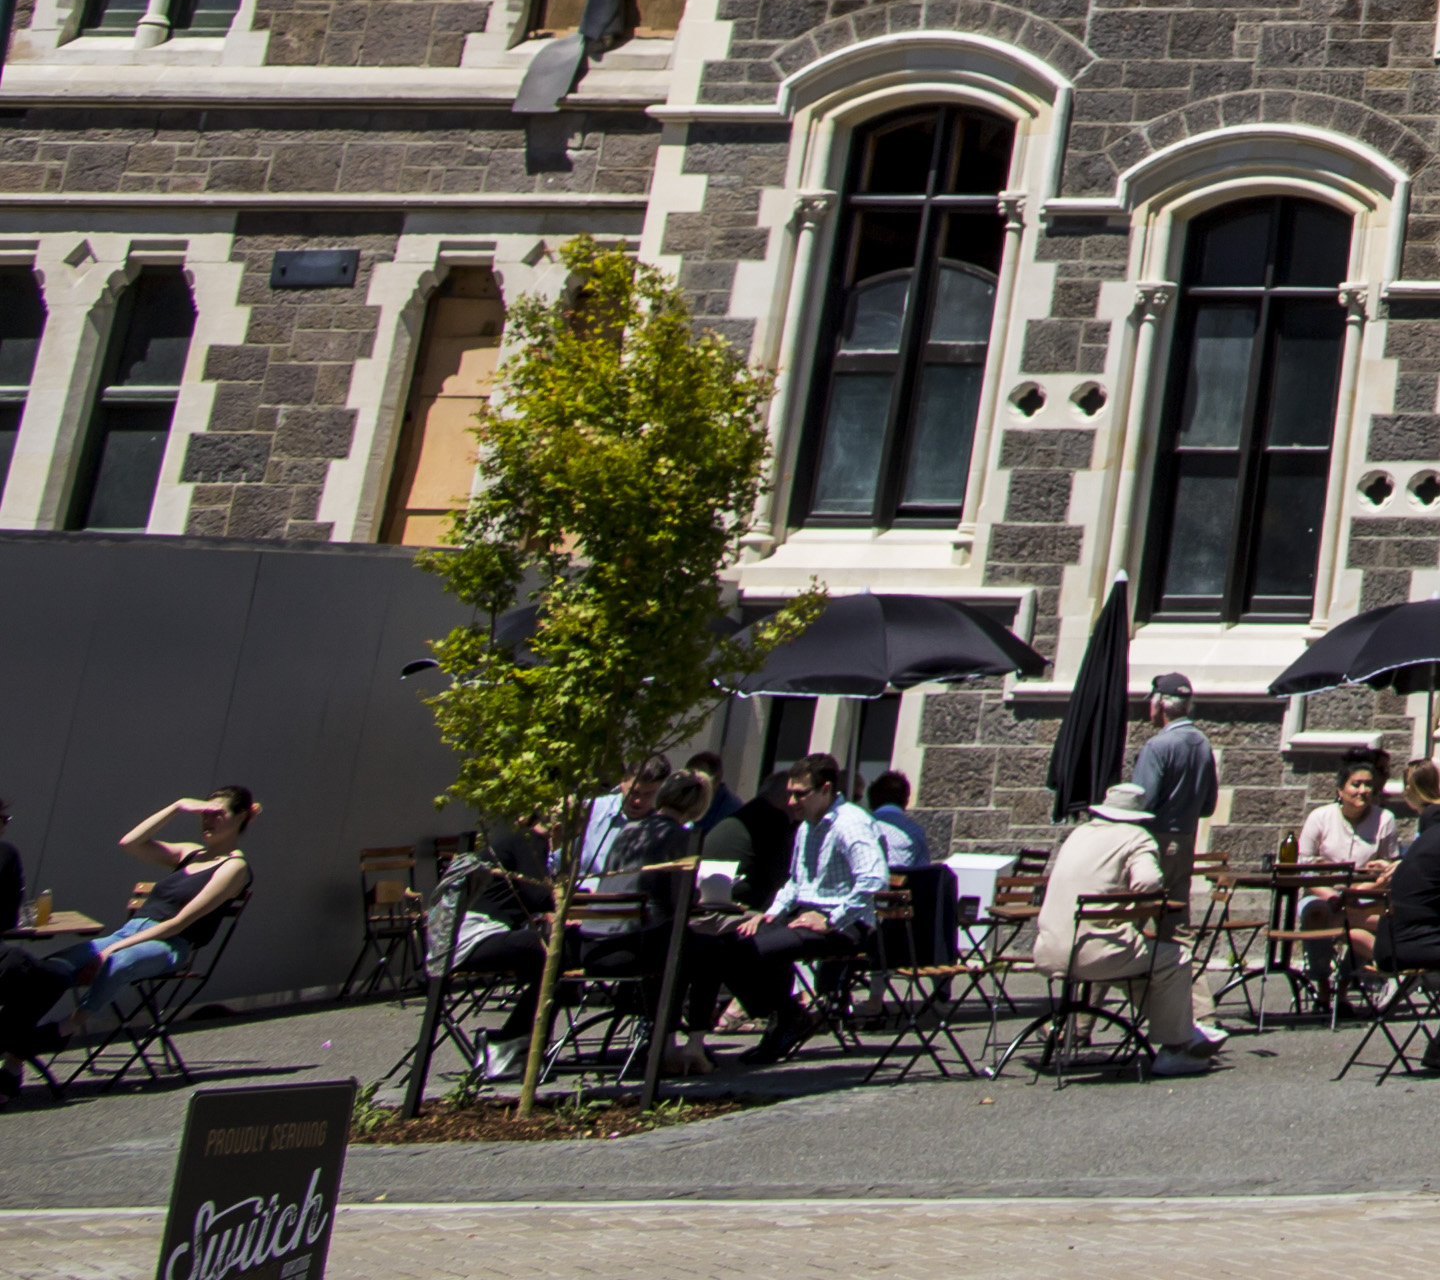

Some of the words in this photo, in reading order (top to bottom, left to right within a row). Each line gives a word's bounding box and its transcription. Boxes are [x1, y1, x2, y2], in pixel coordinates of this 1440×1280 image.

[204, 1125, 269, 1156] PROUDLY
[270, 1120, 328, 1151] SERVING
[165, 1167, 328, 1280] Switch
